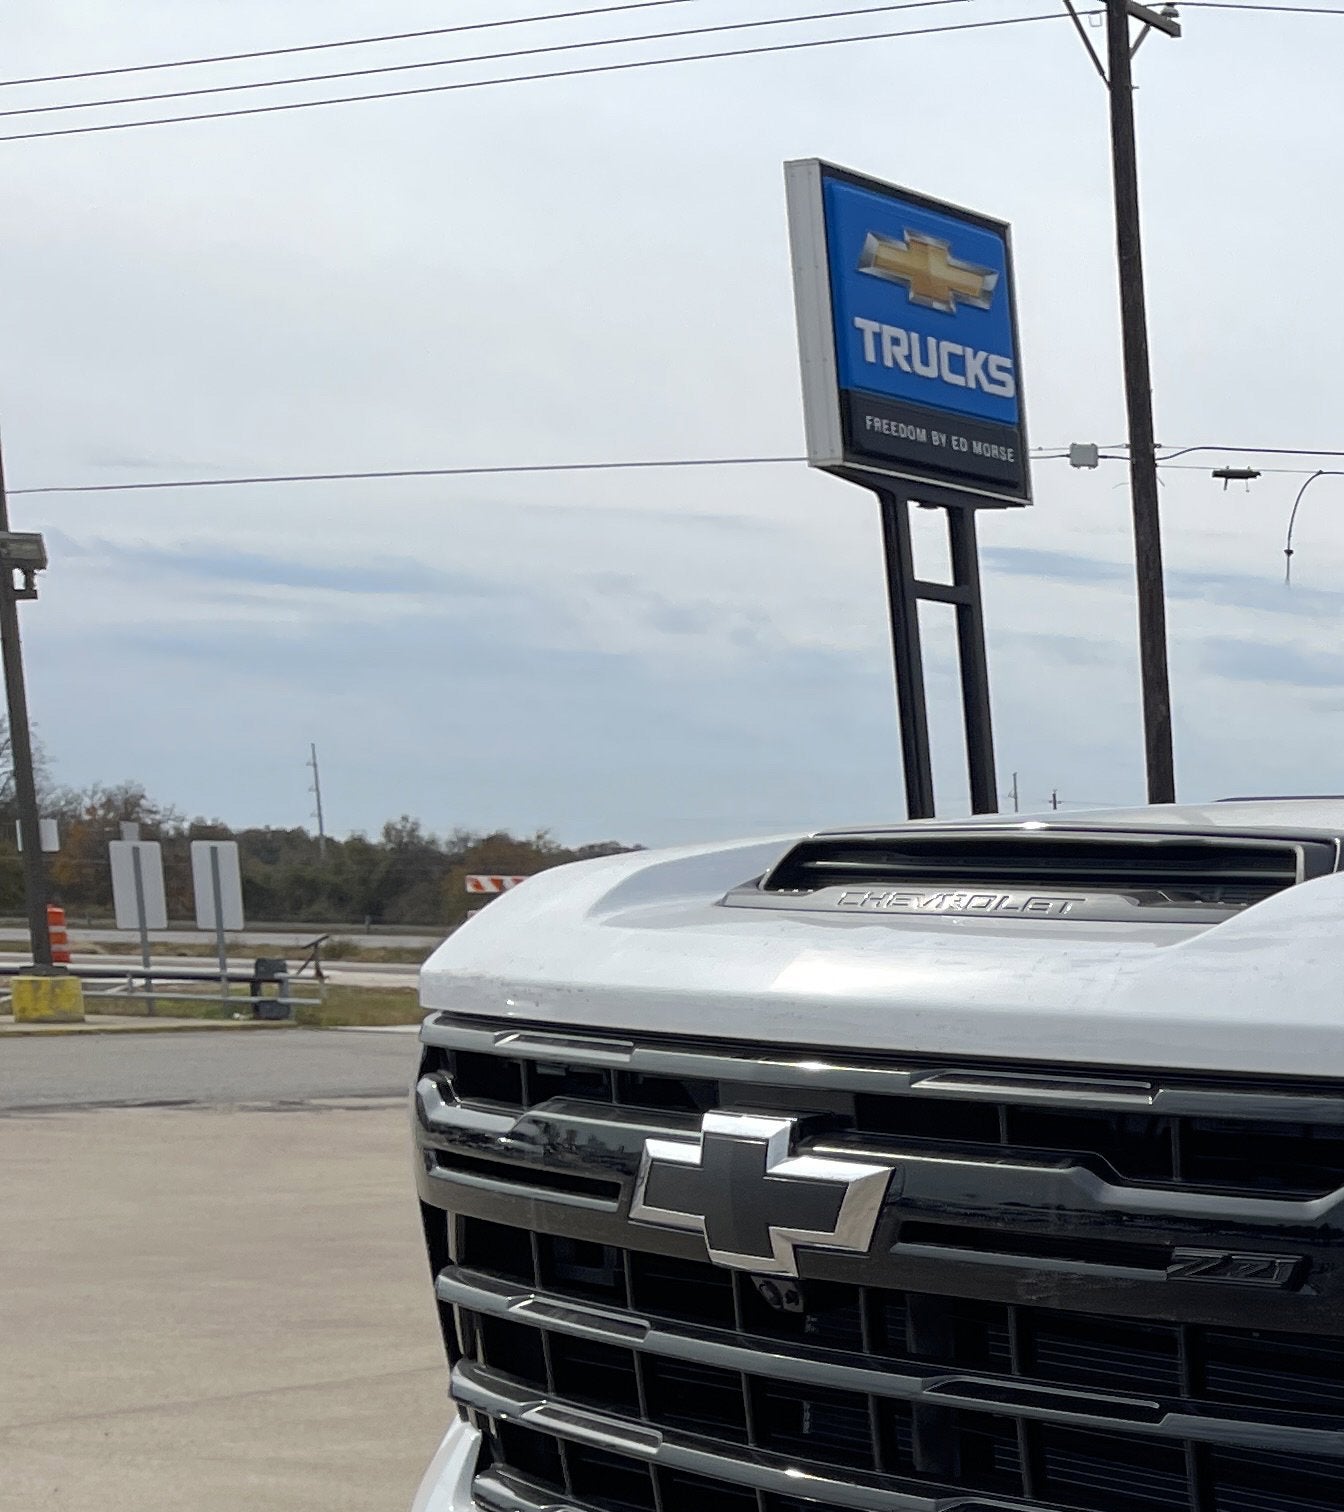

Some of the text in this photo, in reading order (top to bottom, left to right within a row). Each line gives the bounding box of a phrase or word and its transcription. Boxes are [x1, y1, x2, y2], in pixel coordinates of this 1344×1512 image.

[853, 316, 1015, 398] TRUCKS
[865, 415, 1015, 463] FREEDOM BY ED MORSE
[837, 890, 1087, 915] CHEVROLET
